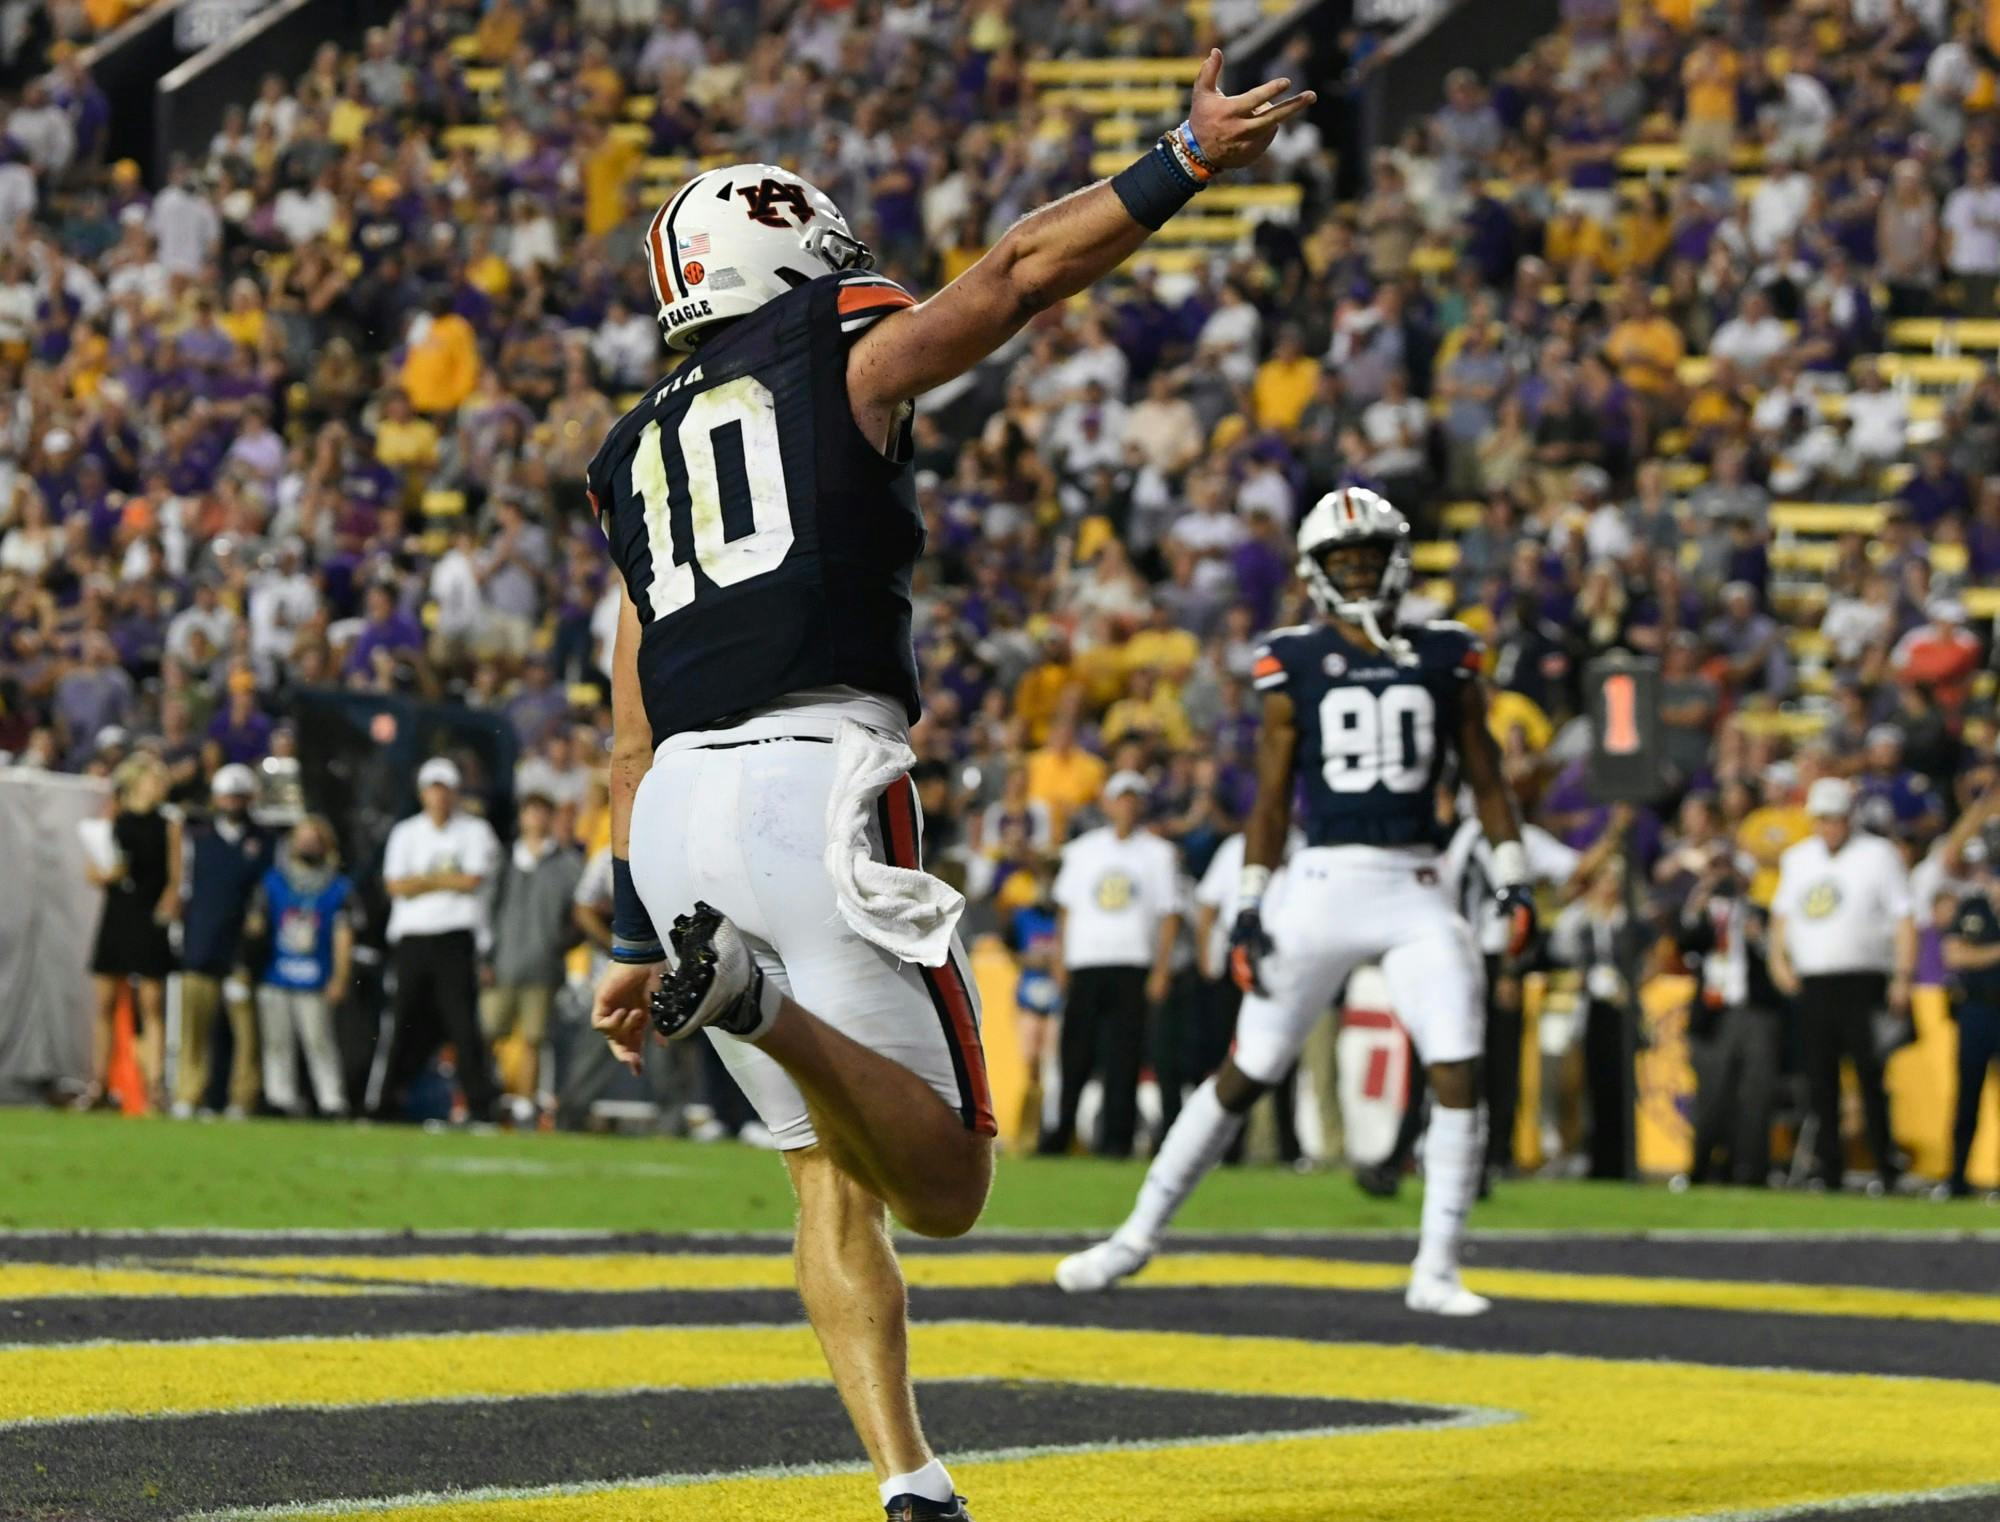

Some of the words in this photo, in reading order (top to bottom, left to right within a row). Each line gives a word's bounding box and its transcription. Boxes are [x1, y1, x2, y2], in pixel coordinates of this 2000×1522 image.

[668, 300, 713, 327] EAGLE
[631, 374, 795, 622] 10
[1319, 684, 1437, 794] 90
[1603, 673, 1640, 754] 1
